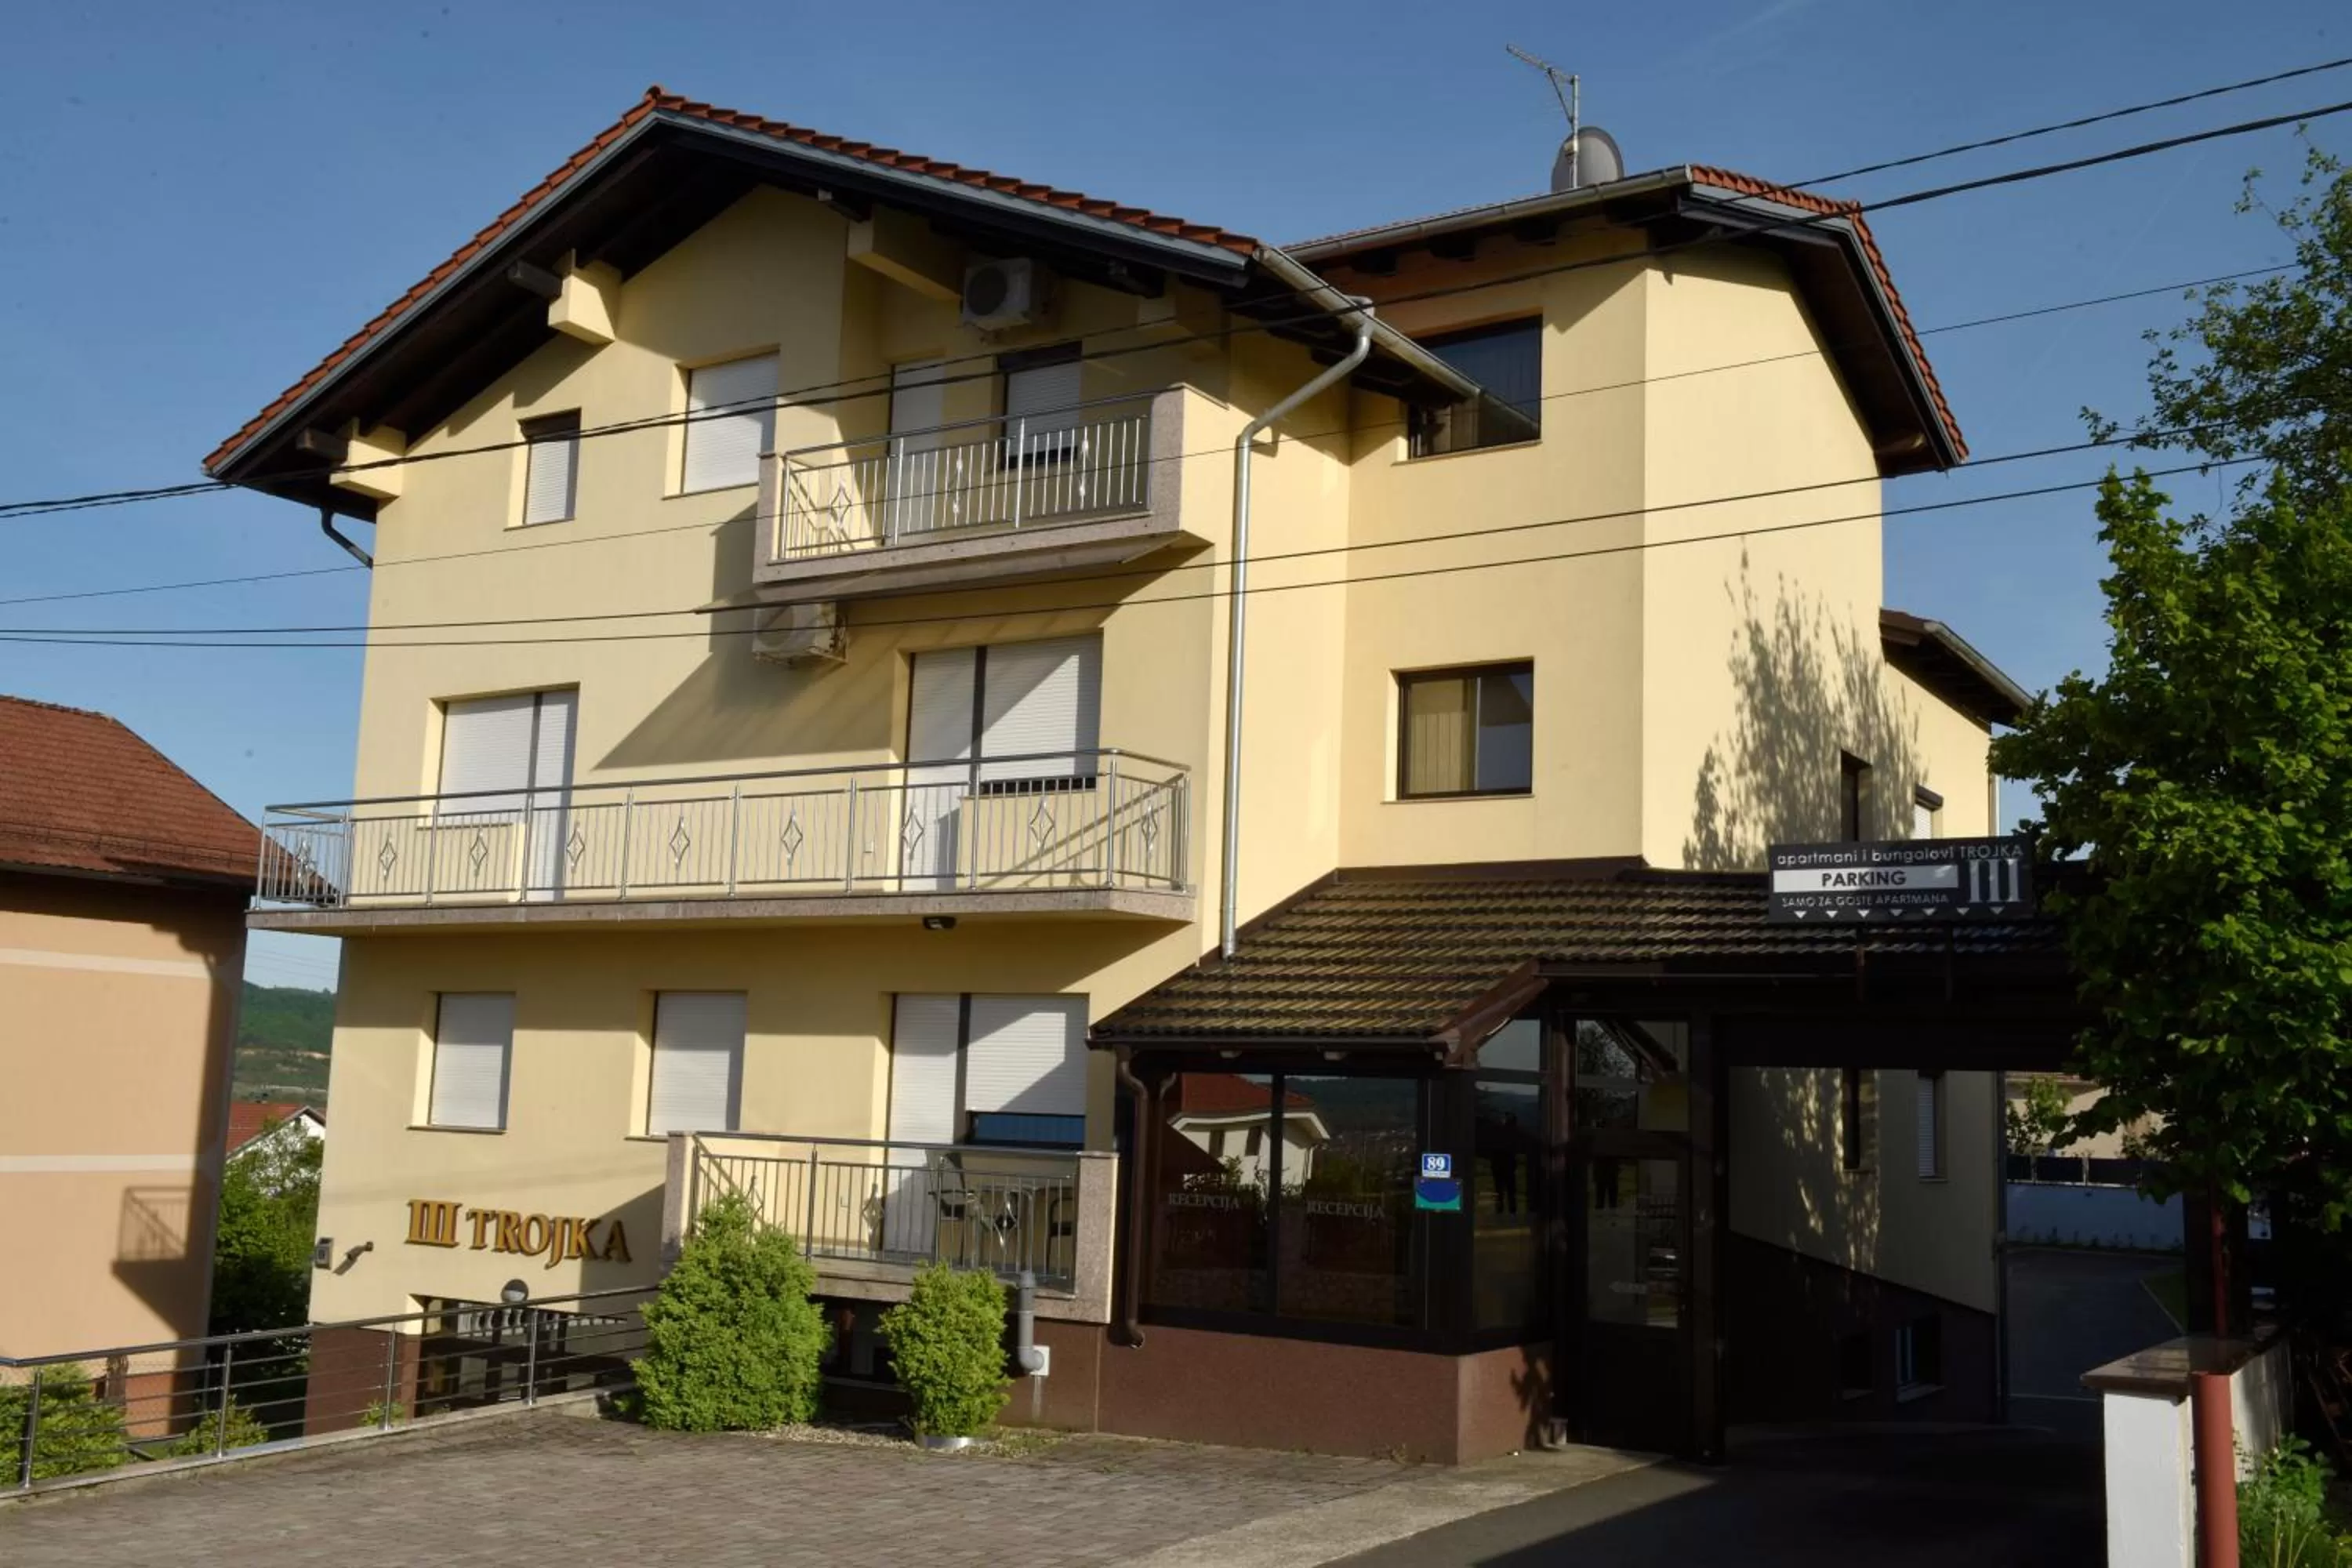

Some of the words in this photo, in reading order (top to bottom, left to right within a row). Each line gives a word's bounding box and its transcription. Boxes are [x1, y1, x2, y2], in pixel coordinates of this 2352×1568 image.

[1777, 851, 1857, 866] apartmani
[1871, 846, 1954, 863] bungalovi
[1960, 844, 2024, 859] TROJKA
[1821, 871, 1907, 887] PARKING
[1781, 897, 1816, 908] SAMO
[1818, 896, 1832, 907] ZA
[1875, 892, 1950, 905] APARTMANA
[1427, 1156, 1446, 1171] 89
[1168, 1192, 1241, 1211] RECEPCIJA
[1306, 1200, 1385, 1220] RECEPCIJA
[465, 1207, 633, 1271] TROJKA
